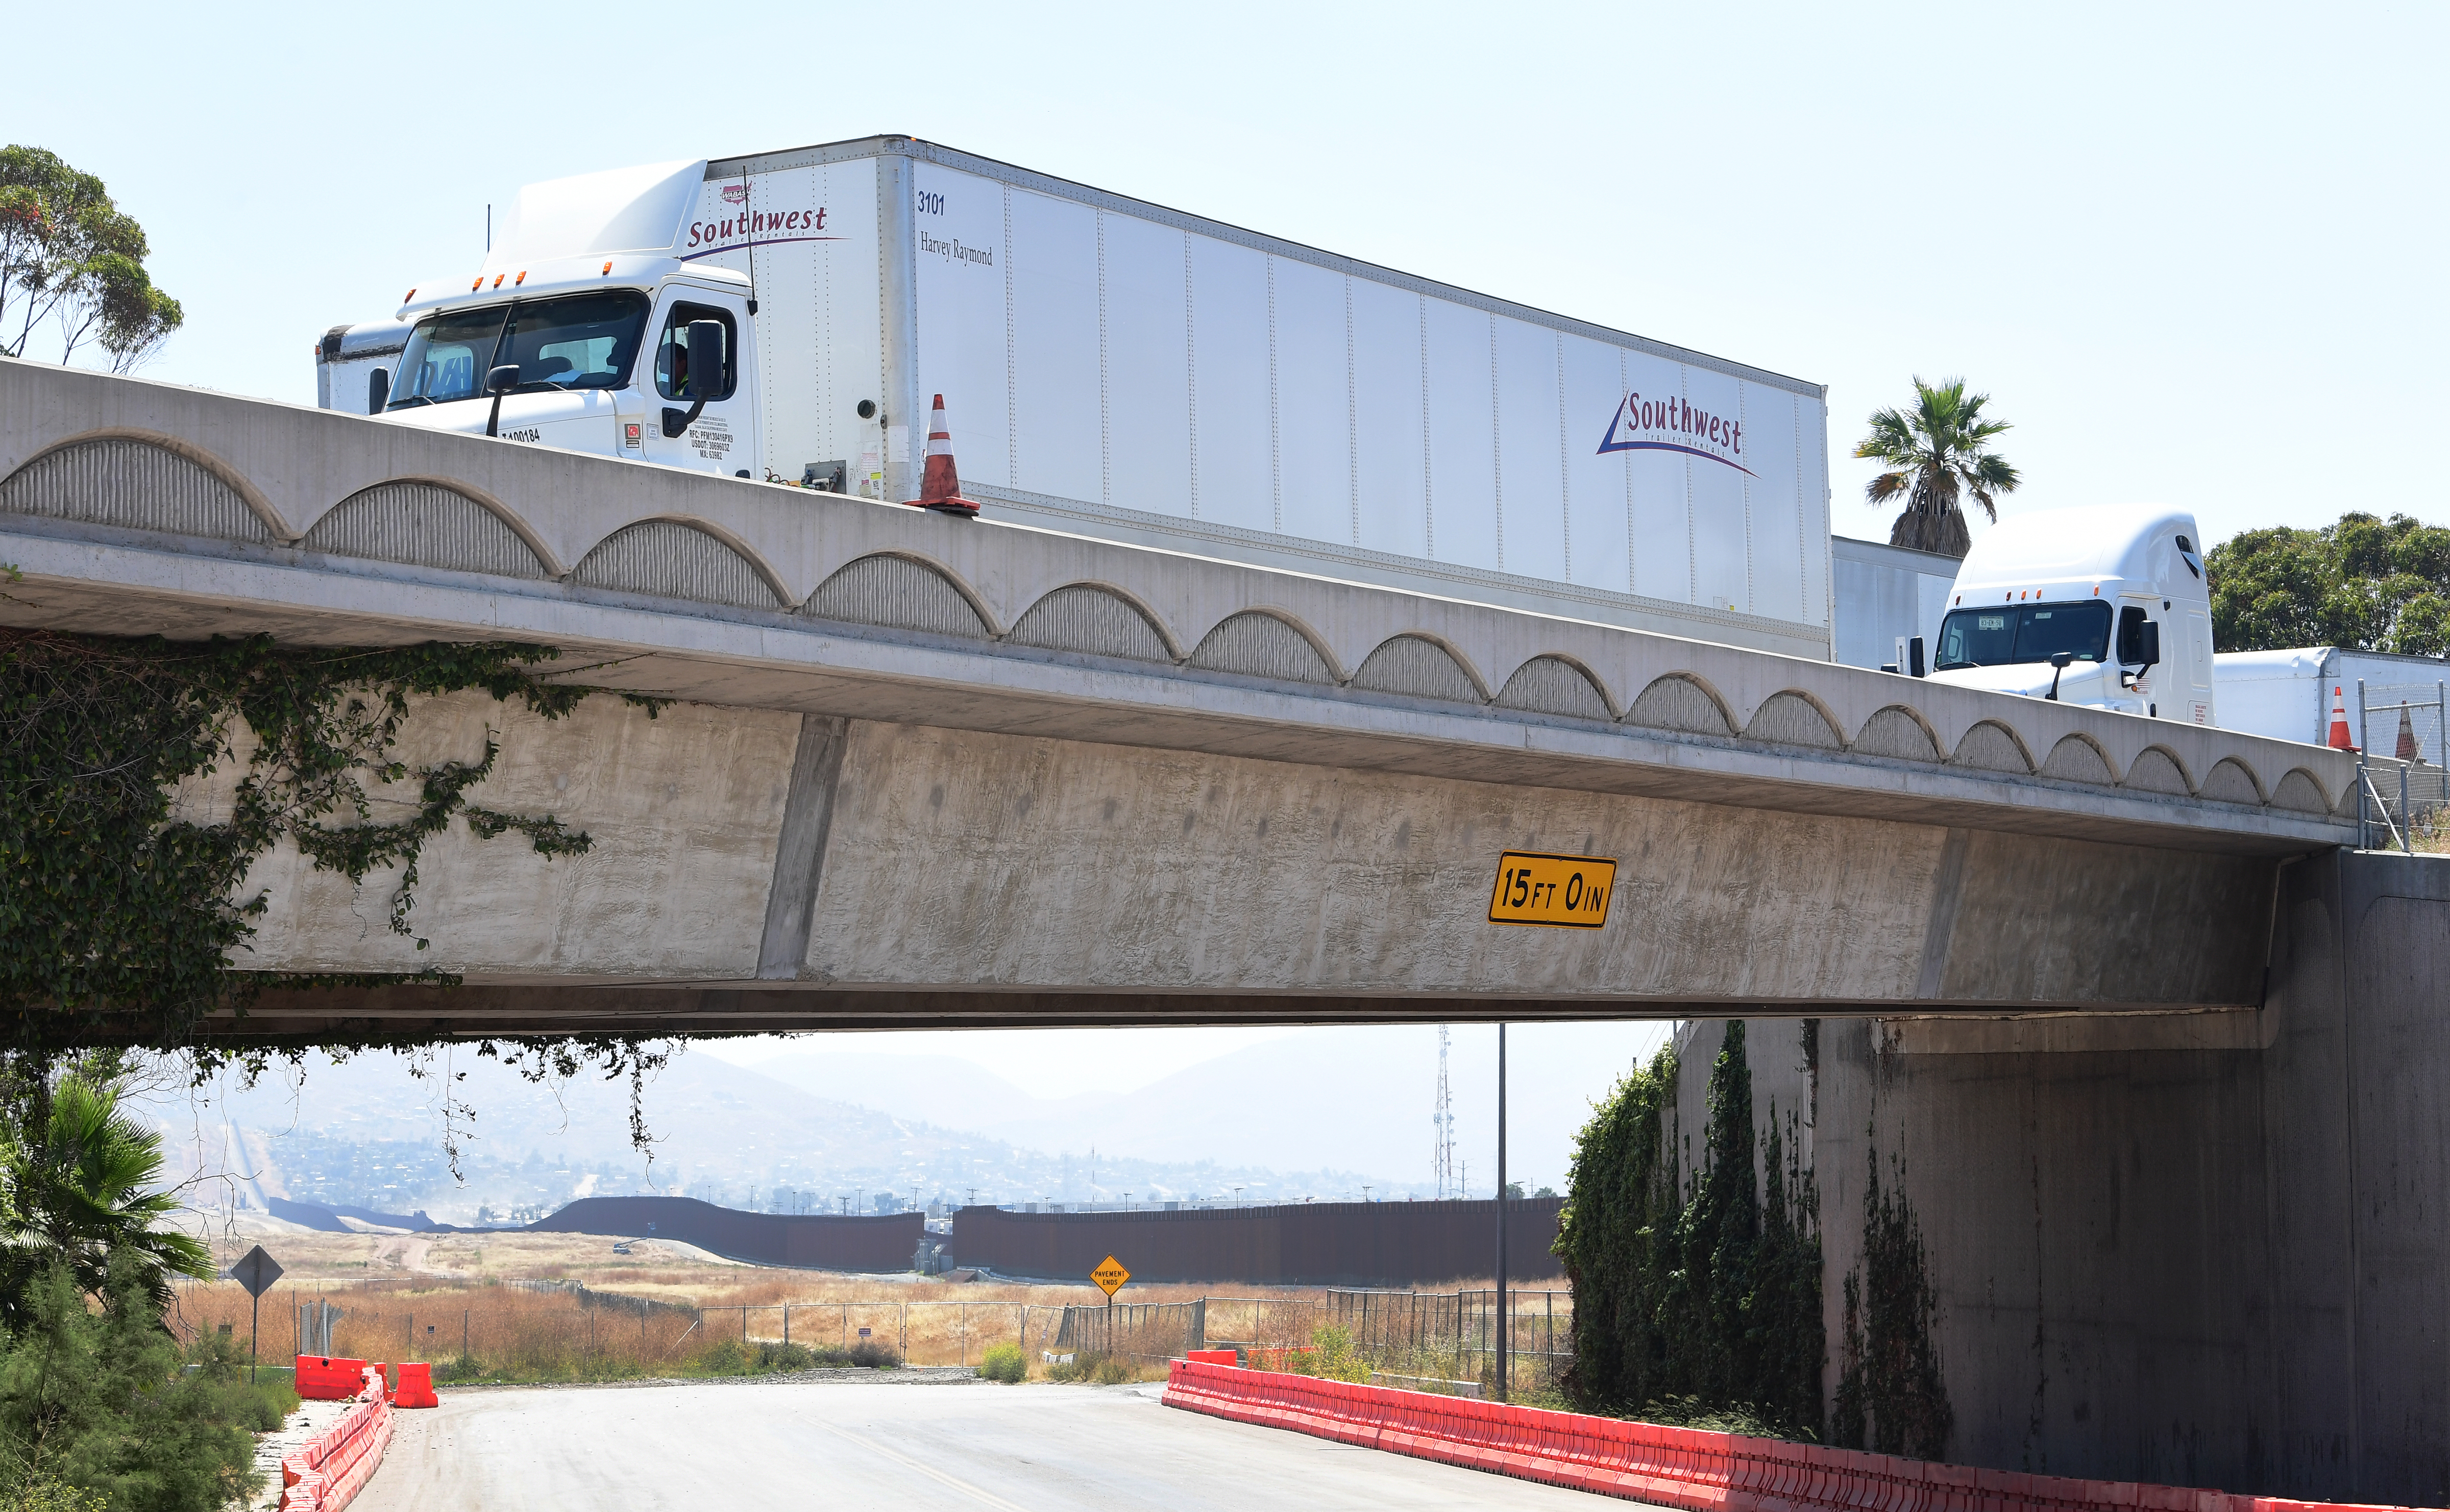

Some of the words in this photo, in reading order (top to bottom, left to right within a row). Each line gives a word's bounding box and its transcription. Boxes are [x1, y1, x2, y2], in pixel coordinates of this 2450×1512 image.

[918, 190, 944, 216] 3101
[687, 207, 827, 248] Southwest
[708, 237, 745, 250] Traile
[920, 231, 951, 263] Harvey
[953, 238, 993, 267] Raymond
[689, 429, 700, 439] RFC:
[700, 431, 733, 443] PFM130416PX9
[1628, 392, 1742, 455] Southwest
[691, 439, 708, 450] USDOT:
[700, 449, 708, 458] MX:
[709, 451, 722, 460] 63982
[1645, 433, 1681, 443] Trailer
[1688, 438, 1725, 458] Rentals
